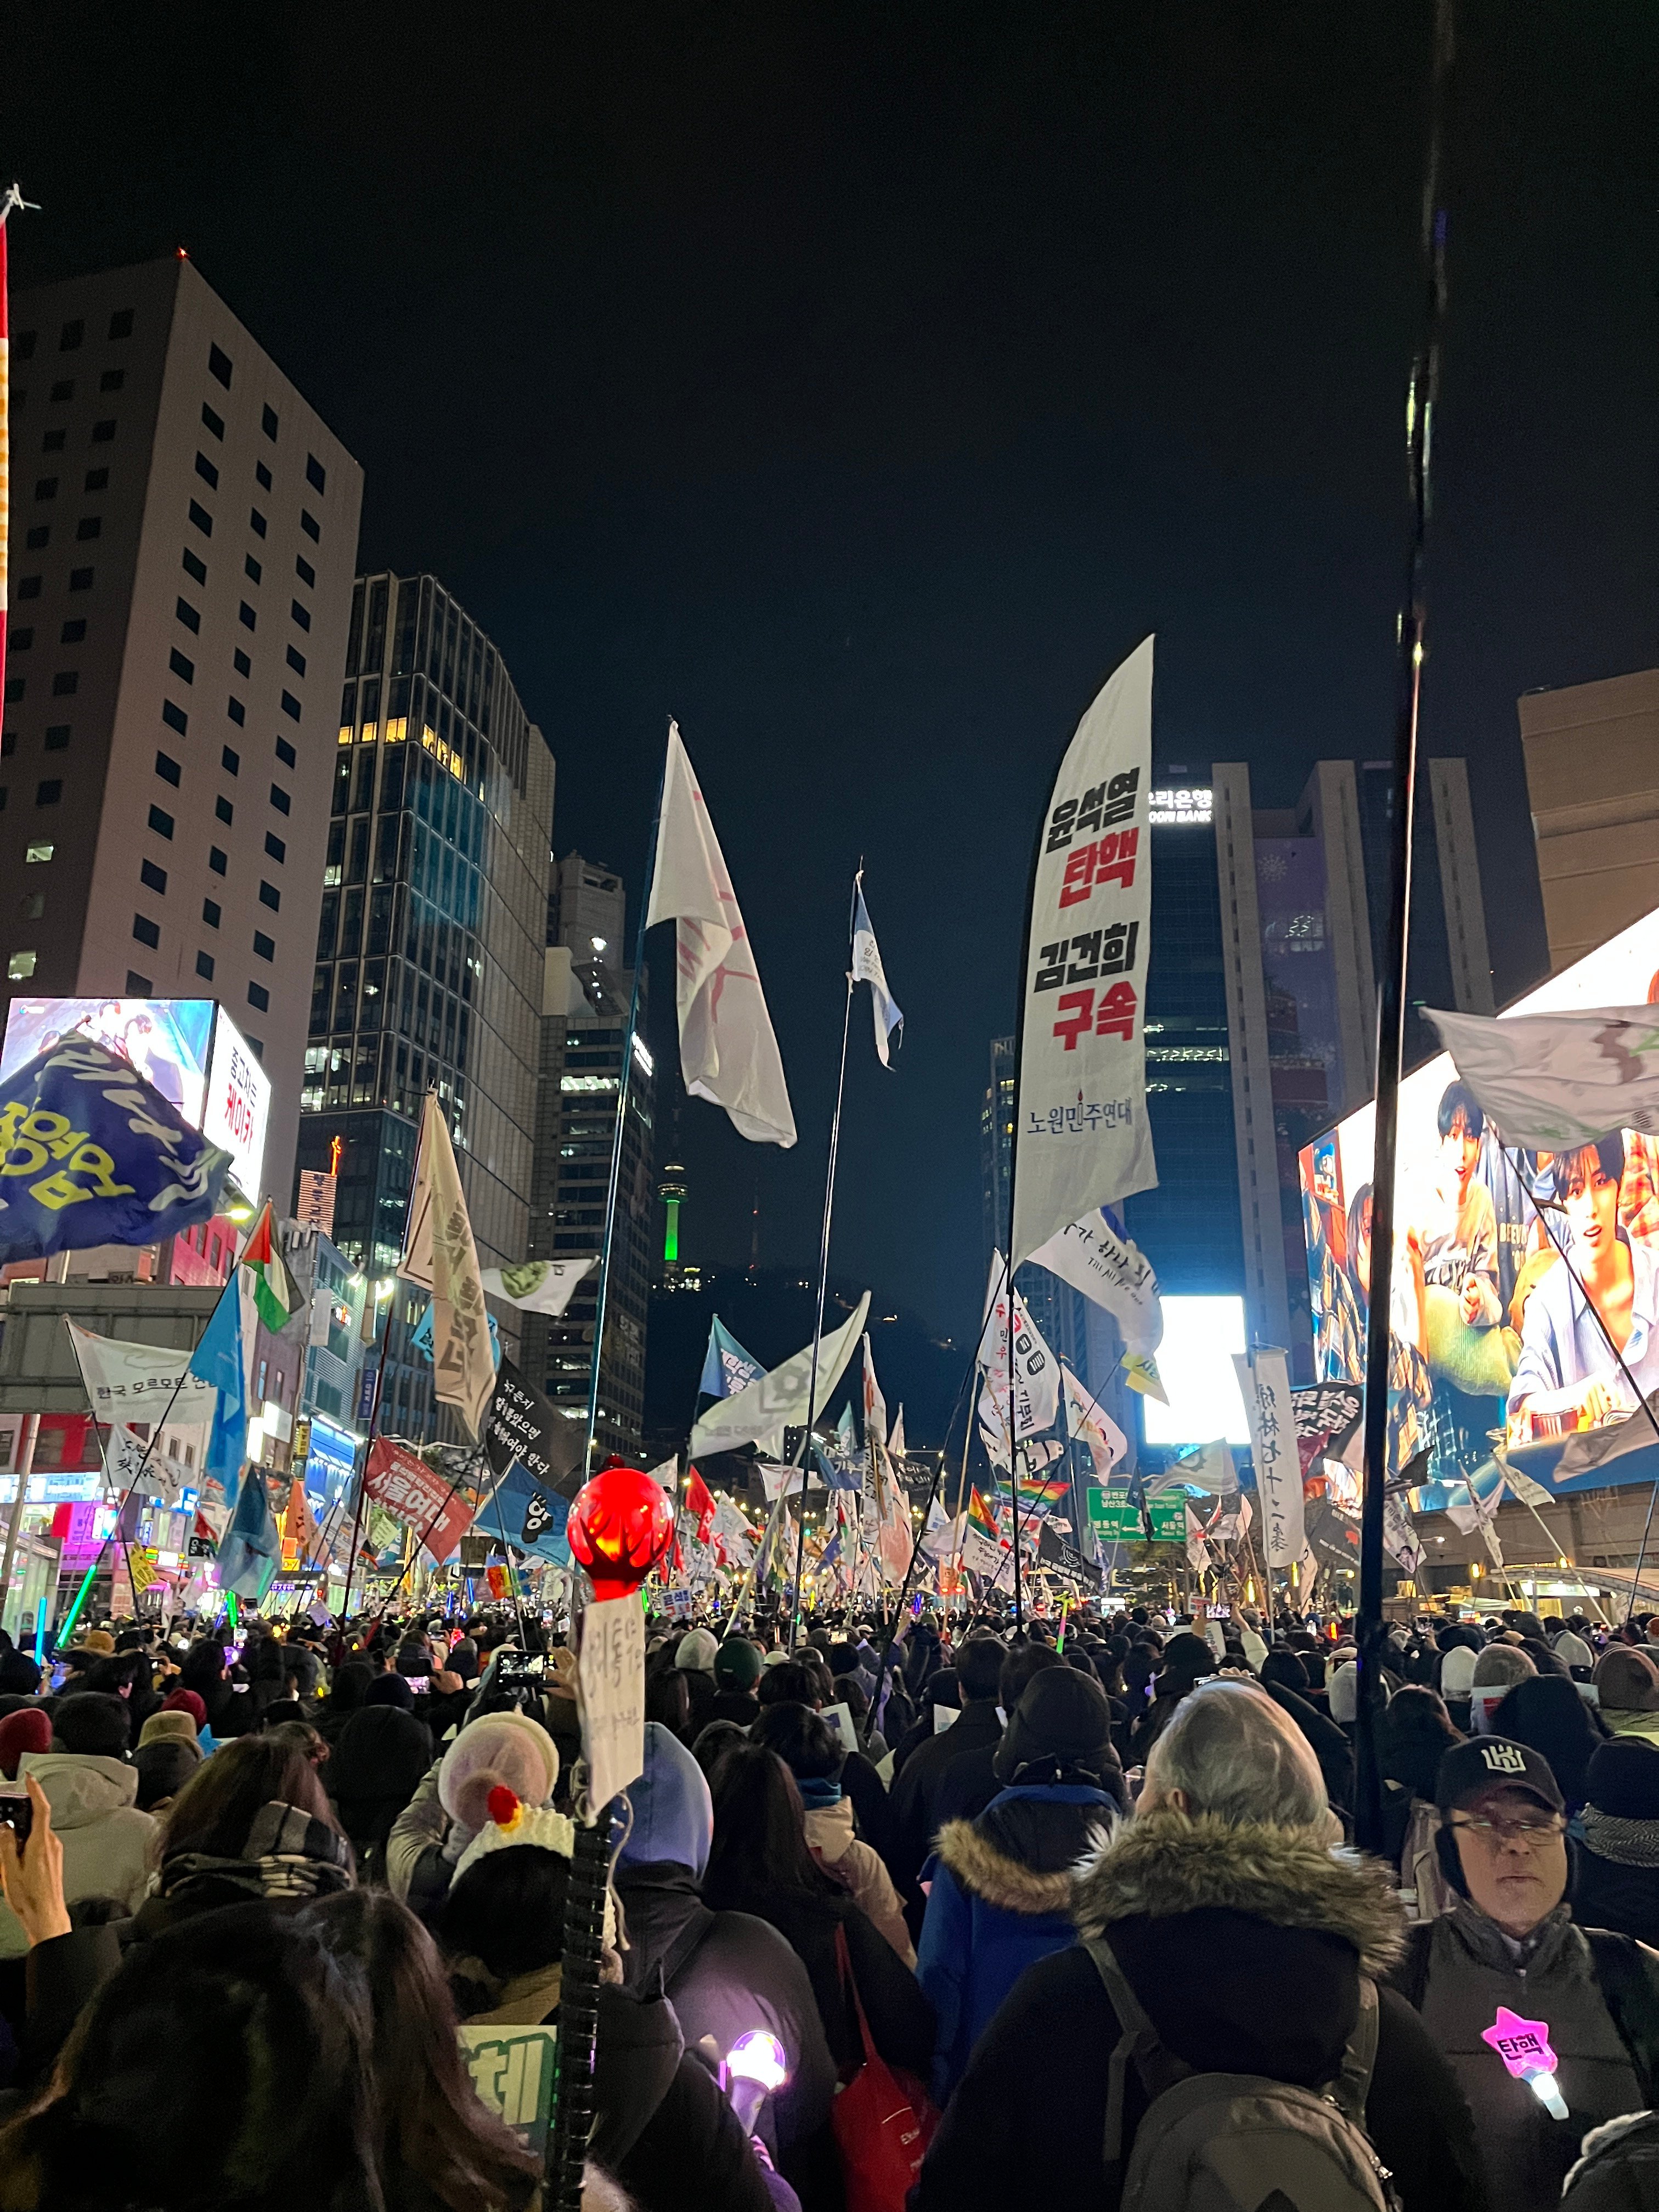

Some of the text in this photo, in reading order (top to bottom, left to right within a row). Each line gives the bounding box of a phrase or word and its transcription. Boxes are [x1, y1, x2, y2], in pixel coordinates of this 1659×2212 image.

[1045, 767, 1141, 854] 윤석열
[1177, 810, 1212, 822] BANK
[1059, 827, 1139, 909] 탄핵
[1034, 921, 1139, 994] 김건희
[1053, 981, 1138, 1051] 구속
[232, 1046, 257, 1108] 중고차는
[224, 1082, 254, 1154] 케이카
[1028, 1097, 1132, 1134] 노원민주연대
[1098, 1240, 1130, 1269] 하나
[503, 1379, 535, 1410] 누구든지
[368, 1471, 450, 1532] 서울여대
[1111, 1491, 1128, 1499] 반포
[1497, 2033, 1544, 2061] 탄핵
